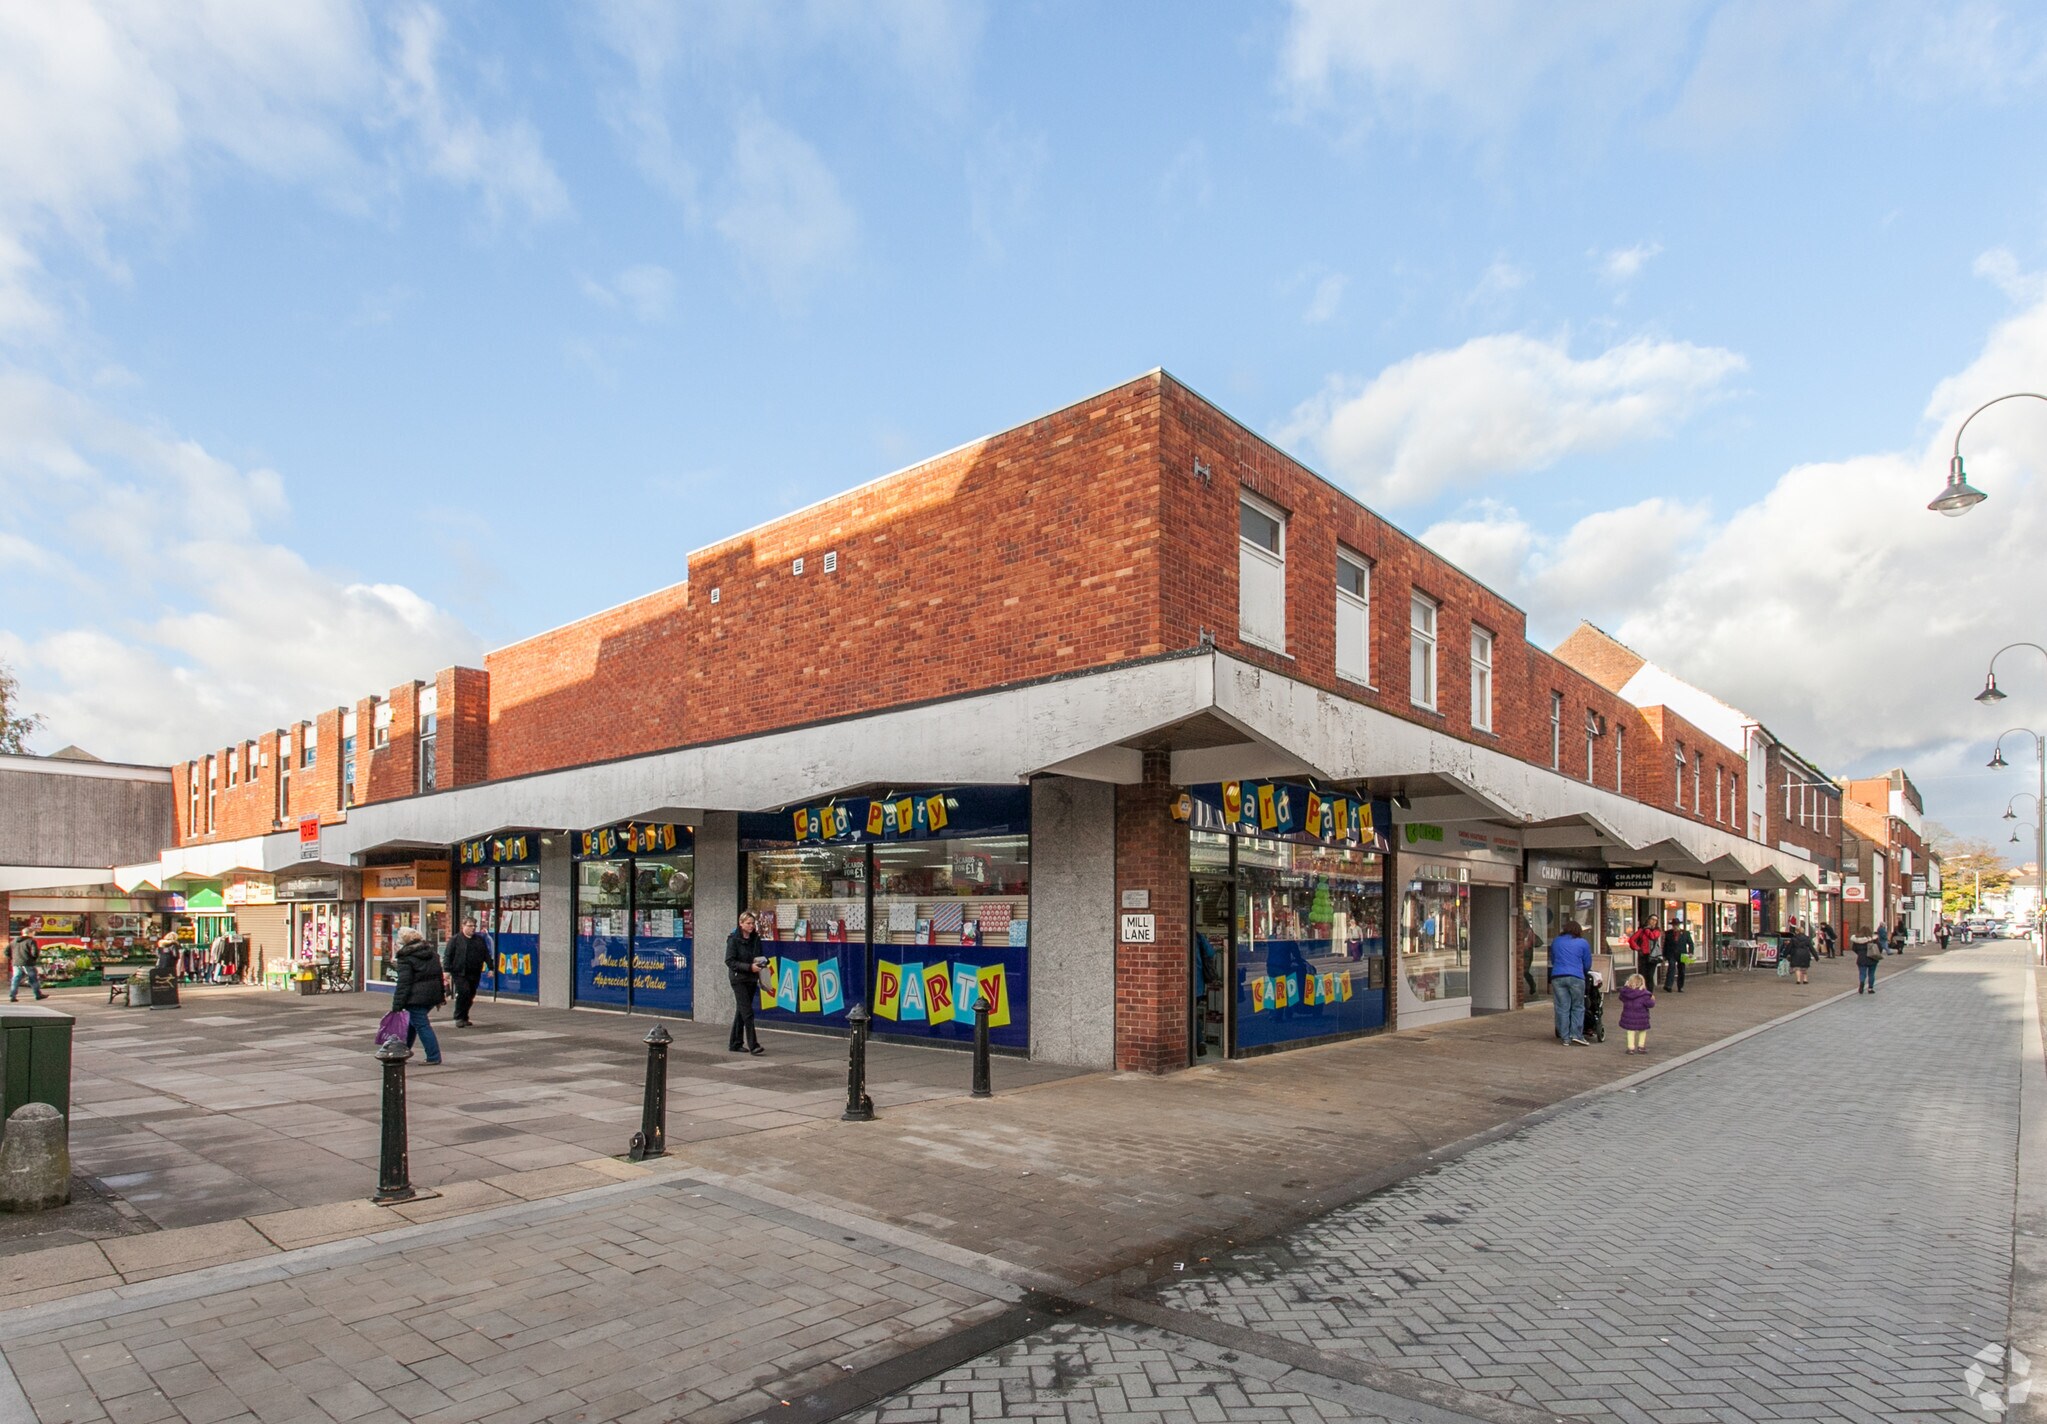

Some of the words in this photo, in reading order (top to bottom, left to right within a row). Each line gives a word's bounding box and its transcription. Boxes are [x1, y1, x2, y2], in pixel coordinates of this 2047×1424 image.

[1225, 781, 1290, 823] Card
[795, 805, 847, 833] Card
[868, 798, 942, 827] Party
[583, 828, 616, 851] Card
[629, 824, 674, 848] Party
[461, 840, 485, 860] Card
[493, 836, 527, 858] Party
[843, 867, 855, 876] FOR
[854, 866, 864, 878] £1
[953, 865, 966, 873] FOR
[965, 863, 976, 875] £1
[1541, 865, 1571, 882] CHAPMAN
[1571, 871, 1599, 885] OPTICIANS
[1615, 872, 1652, 880] CHAPMAN
[1127, 916, 1149, 928] MILL
[1124, 929, 1150, 940] LANE
[501, 957, 530, 971] PARTY
[599, 953, 618, 967] Value
[632, 954, 665, 970] Occasion
[633, 975, 645, 989] the
[645, 974, 667, 990] Value
[1254, 978, 1297, 1003] CARD
[1305, 975, 1350, 999] PARTY
[879, 969, 1002, 1016] PARTY
